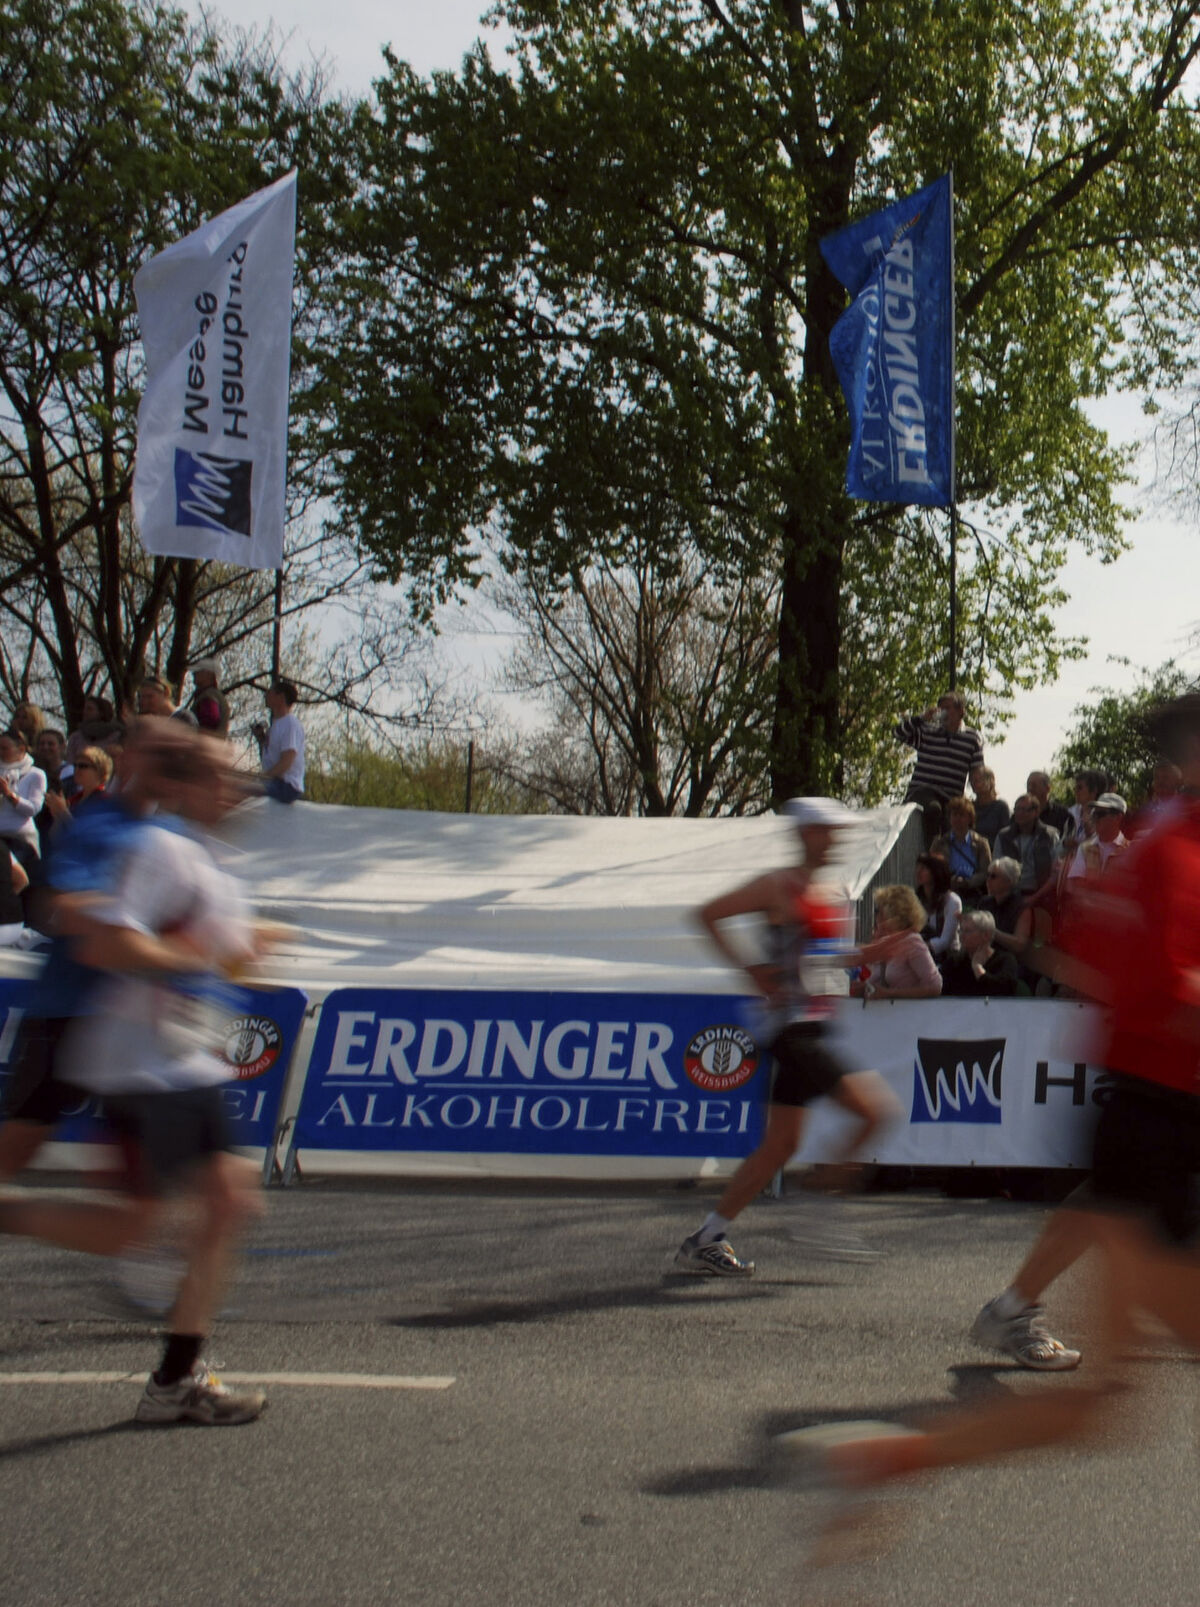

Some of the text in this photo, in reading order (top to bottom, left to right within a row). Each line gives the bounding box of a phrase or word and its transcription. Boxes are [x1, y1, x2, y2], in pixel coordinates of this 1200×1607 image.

[224, 1018, 278, 1045] RDINGER
[690, 1027, 754, 1055] ERDINGER
[327, 1010, 678, 1090] ERDINGER
[317, 1093, 751, 1134] ALKOHOLFREI
